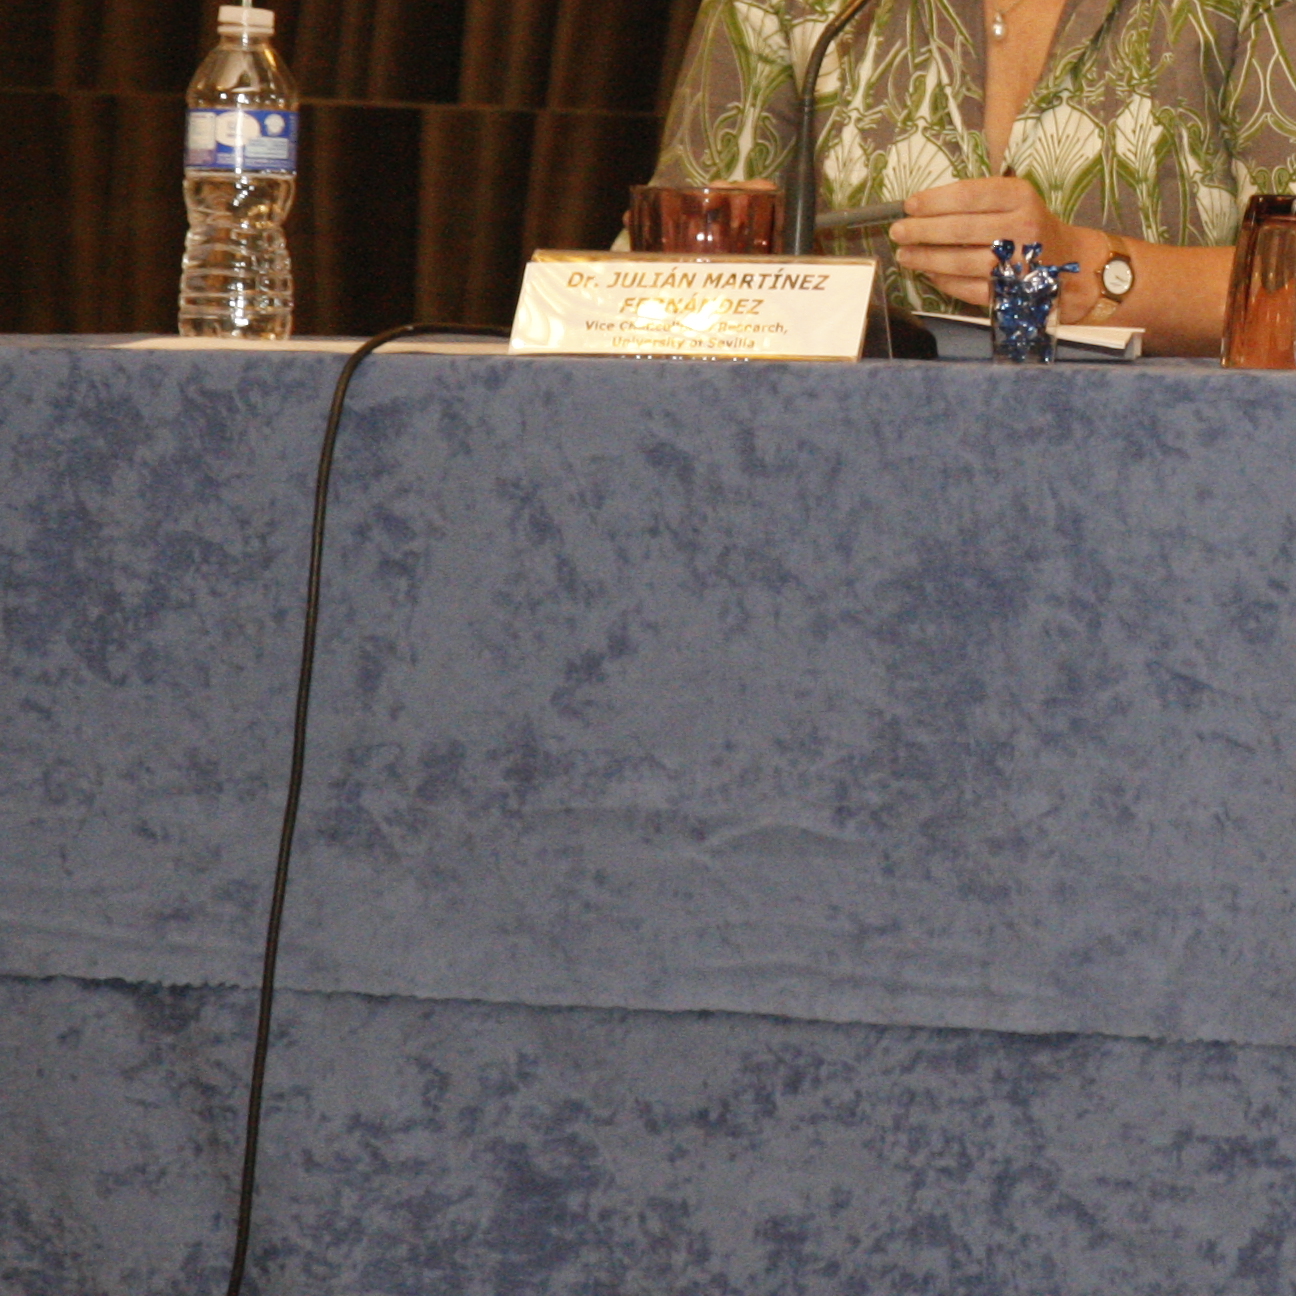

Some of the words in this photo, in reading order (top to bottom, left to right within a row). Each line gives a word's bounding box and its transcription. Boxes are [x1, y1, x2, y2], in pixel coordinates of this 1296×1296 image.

[567, 271, 599, 289] Dr.
[606, 266, 697, 290] JULIÁN
[702, 267, 830, 292] MARTÍNEZ
[707, 337, 756, 349] Sevilla
